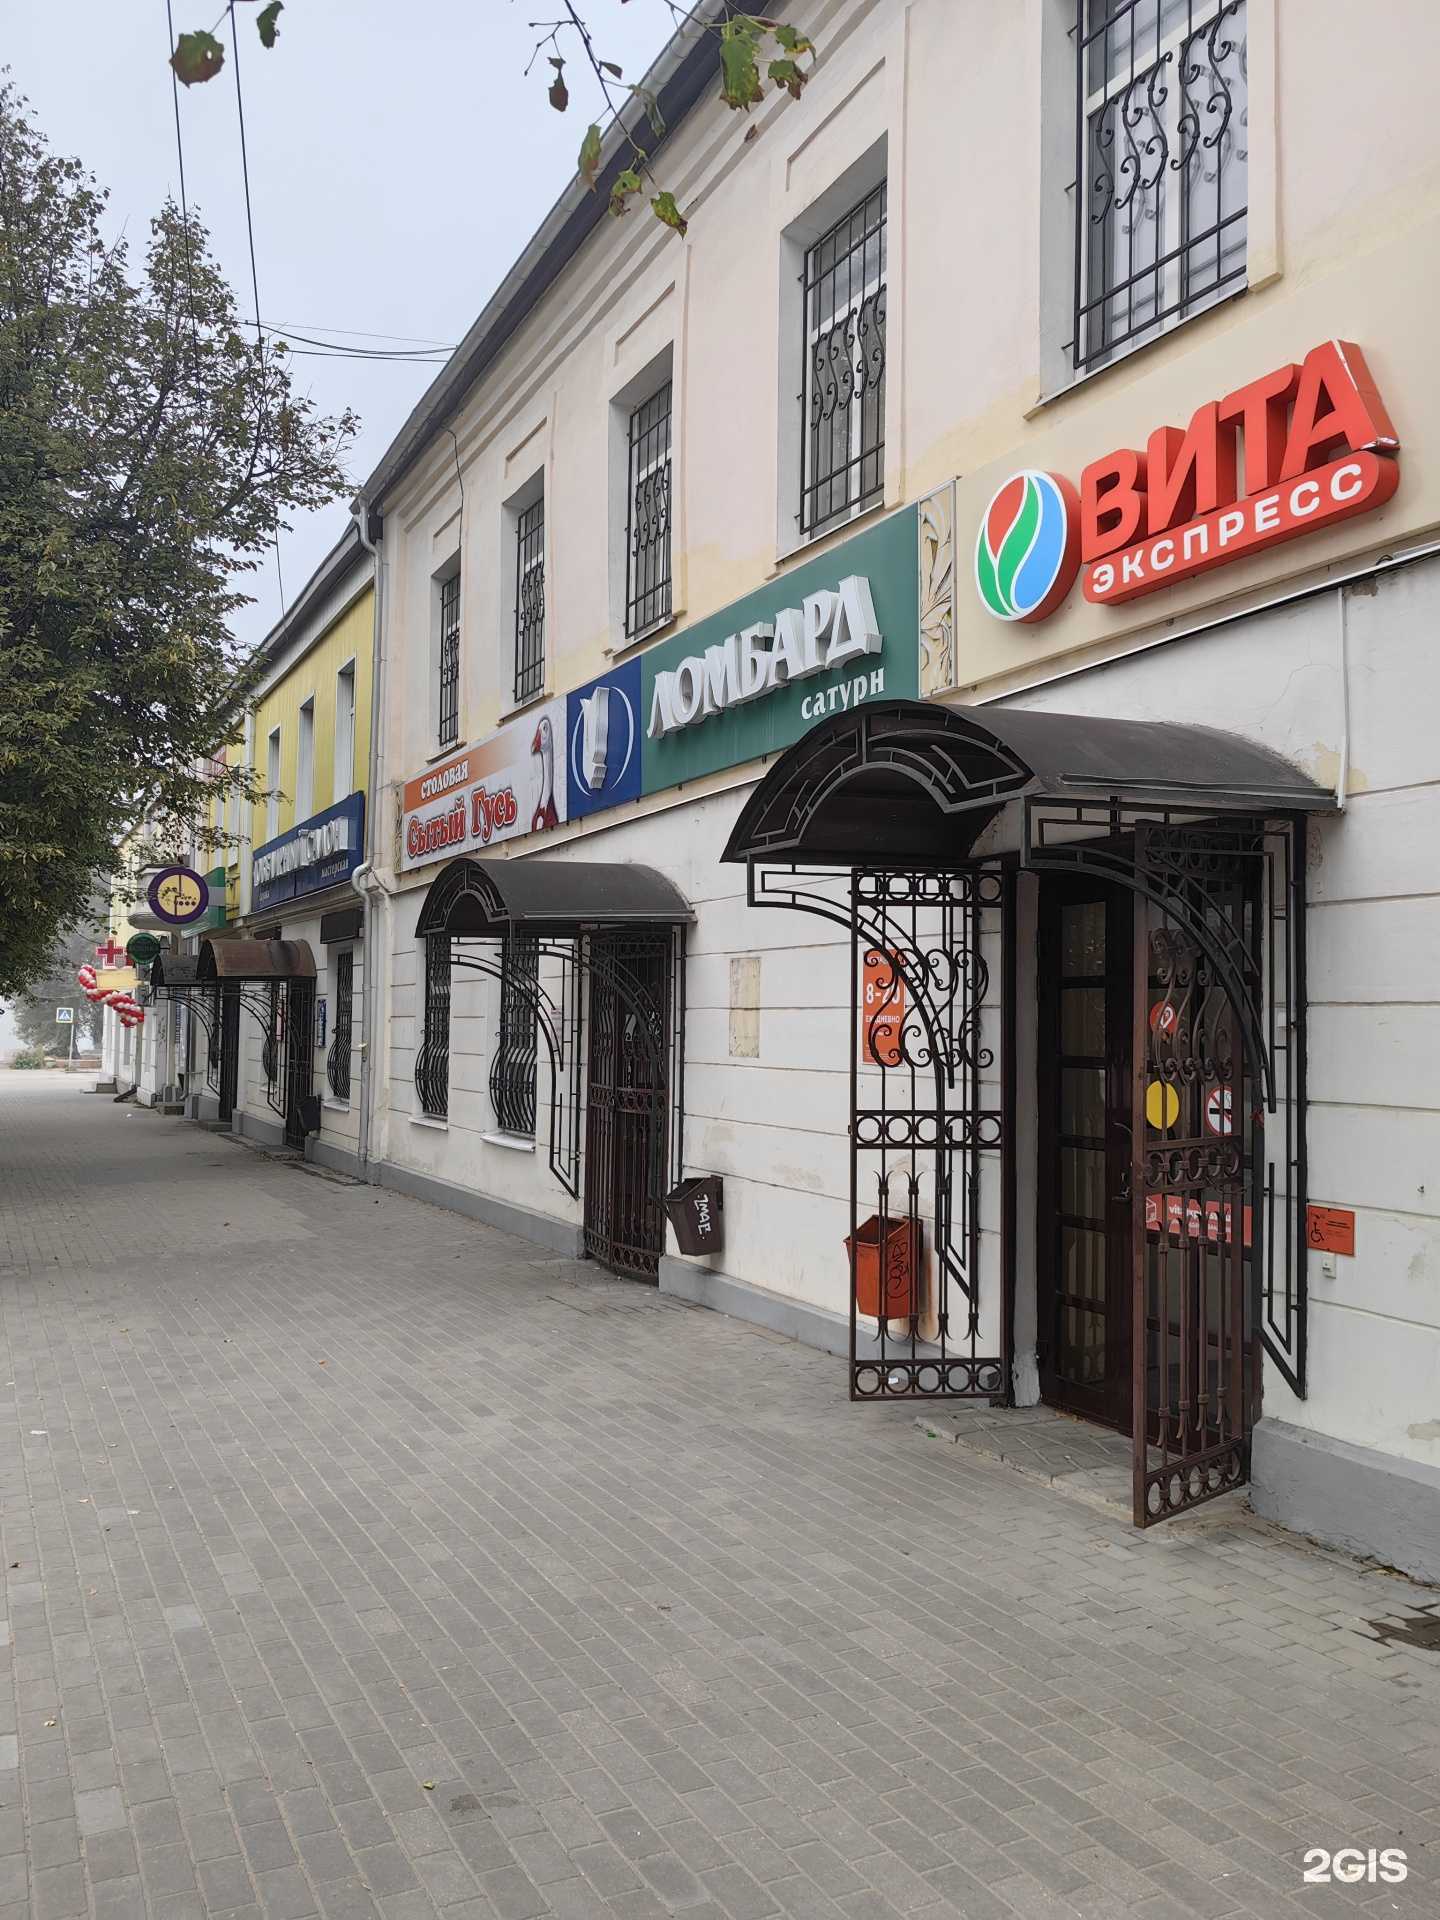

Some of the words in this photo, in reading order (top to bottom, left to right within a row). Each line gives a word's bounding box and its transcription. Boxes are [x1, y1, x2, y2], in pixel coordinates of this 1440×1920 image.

[1081, 339, 1398, 564] ВИТА
[1092, 464, 1362, 594] ЭКСПРЕСС
[647, 575, 883, 739] ЛОМБАРД
[801, 668, 885, 720] сатурн
[407, 796, 466, 857] Сытый
[471, 787, 517, 841] Гусь
[421, 760, 469, 799] столовая
